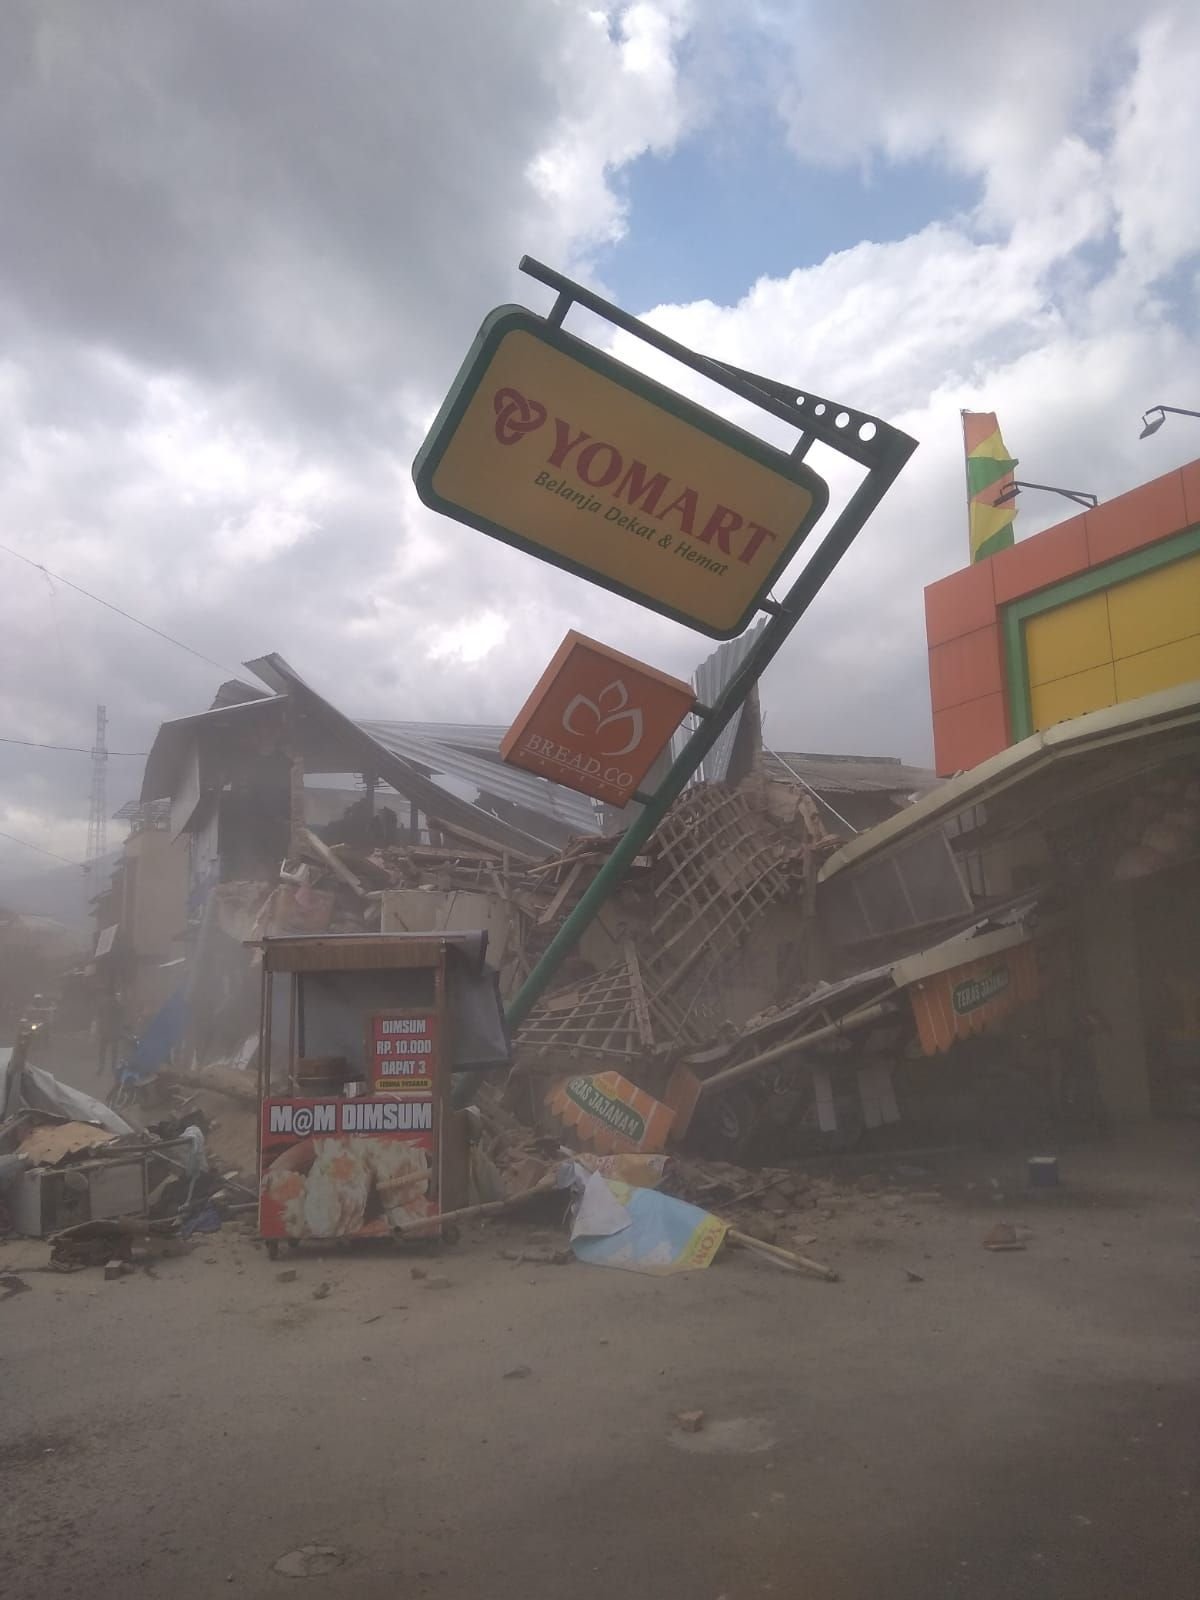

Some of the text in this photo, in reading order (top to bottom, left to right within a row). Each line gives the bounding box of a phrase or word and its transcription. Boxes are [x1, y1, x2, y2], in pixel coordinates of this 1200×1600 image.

[546, 418, 777, 566] YOMART
[534, 471, 729, 577] Belanja Dekat & Hemat
[382, 1019, 426, 1034] DIMSUM
[376, 1040, 393, 1054] RP.
[381, 1060, 426, 1075] DAPAT 3
[270, 1103, 432, 1136] M@M DIMSUM
[588, 1092, 639, 1136] JAJANAN
